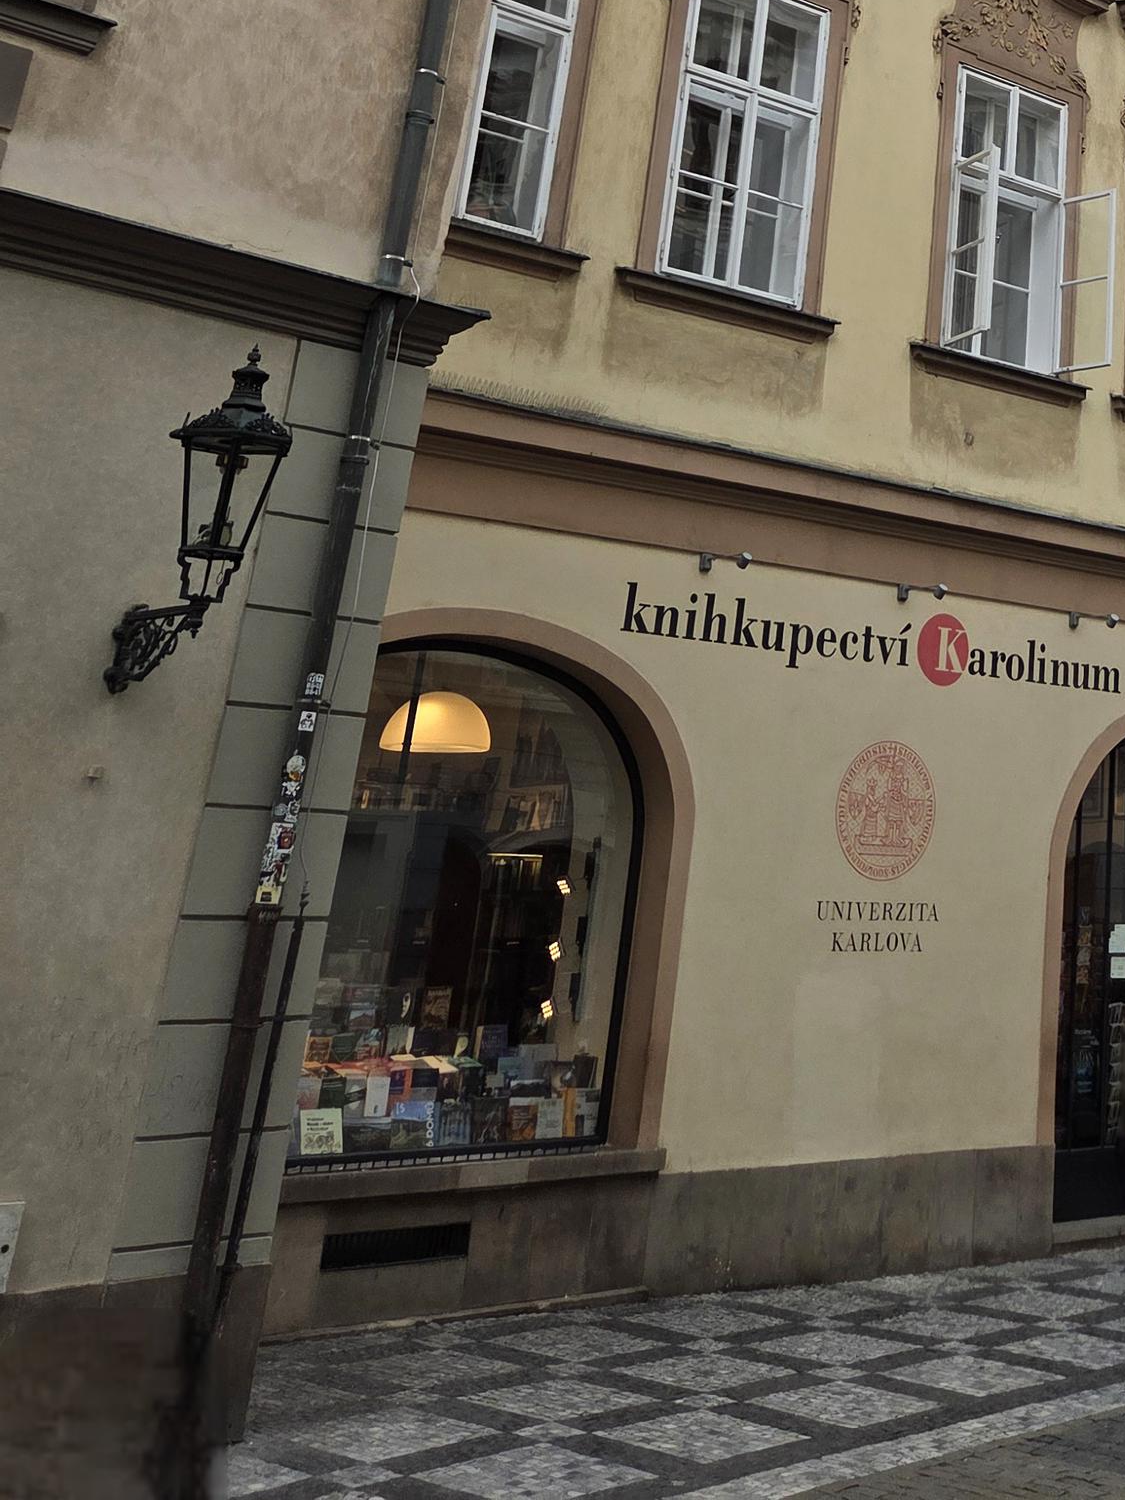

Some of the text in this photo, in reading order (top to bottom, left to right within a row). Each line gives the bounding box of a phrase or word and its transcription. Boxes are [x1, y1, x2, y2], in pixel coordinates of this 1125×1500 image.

[620, 581, 1121, 694] knihkupectví Karolinum
[817, 900, 939, 922] UNIVERZITA
[831, 931, 922, 952] KARLOVA
